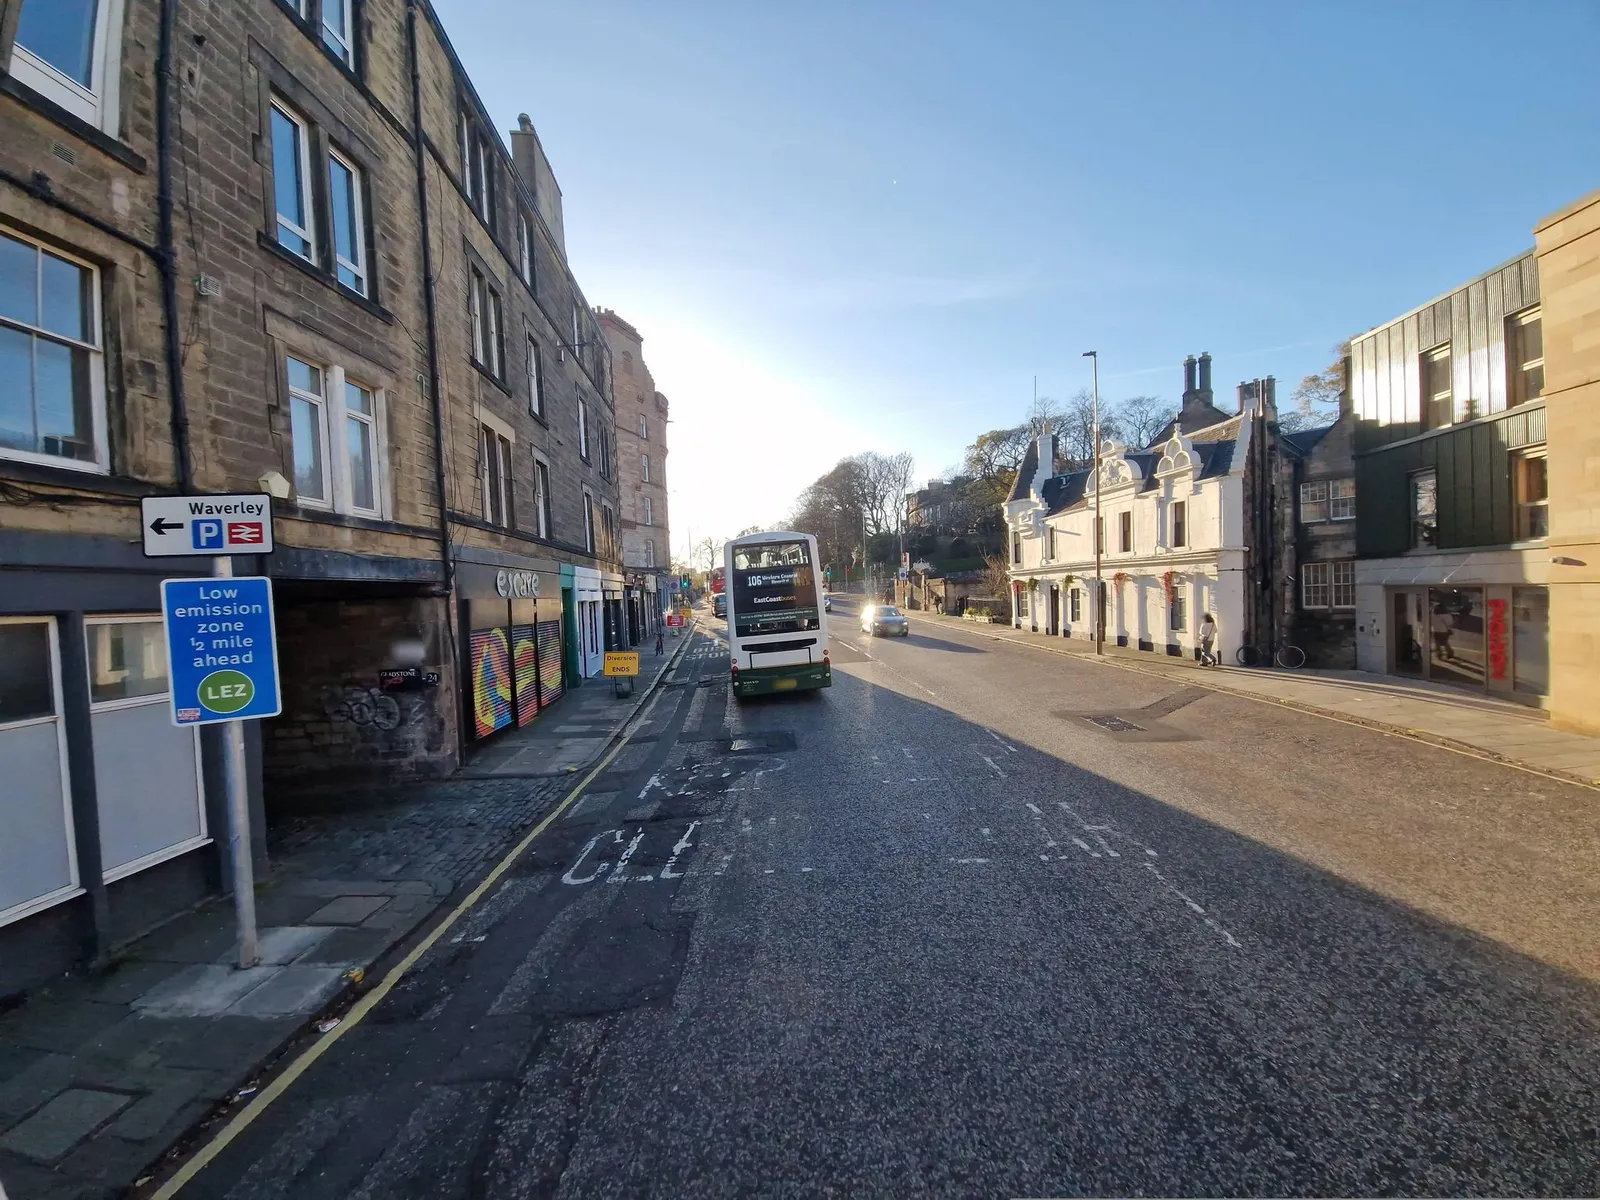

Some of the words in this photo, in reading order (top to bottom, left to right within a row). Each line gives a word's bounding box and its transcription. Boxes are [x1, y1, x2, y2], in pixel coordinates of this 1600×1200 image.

[188, 502, 264, 515] Waverley
[200, 522, 218, 546] P
[748, 576, 762, 586] 106
[200, 587, 238, 600] Low
[175, 603, 262, 617] emission
[198, 622, 244, 633] zone
[212, 635, 253, 648] mile
[193, 651, 253, 668] ahead
[427, 674, 437, 682] 24
[207, 684, 247, 700] LEZ
